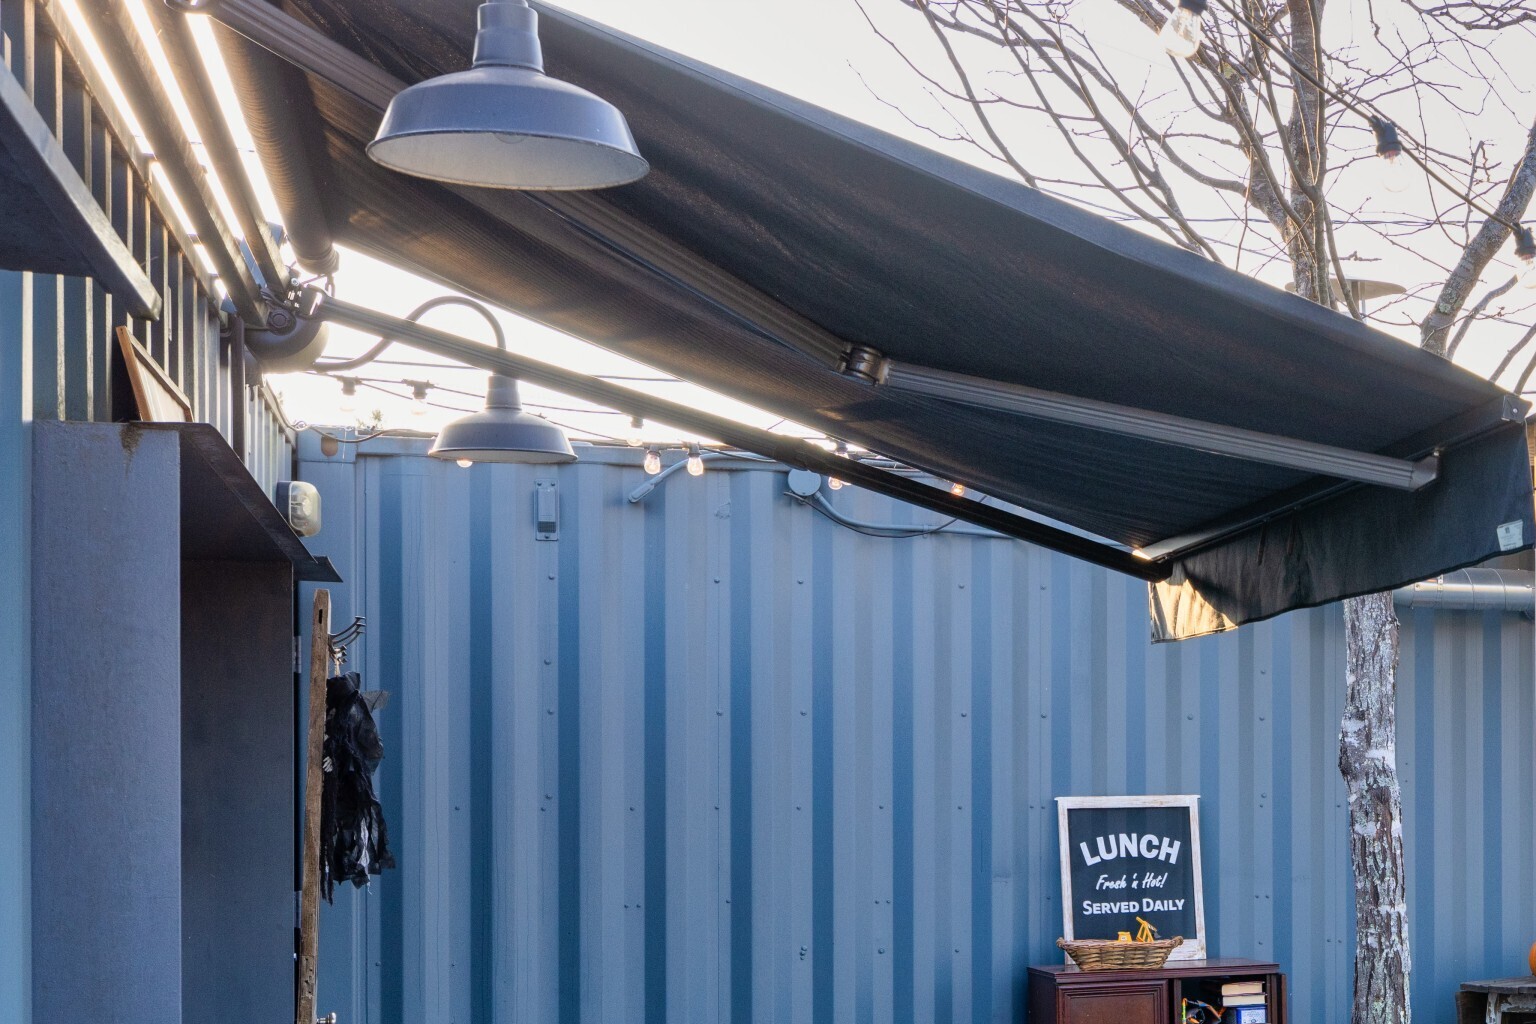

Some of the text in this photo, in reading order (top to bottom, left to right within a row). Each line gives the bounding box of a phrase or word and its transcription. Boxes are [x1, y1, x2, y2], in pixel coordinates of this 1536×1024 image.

[1079, 833, 1181, 866] LUNCH
[1095, 874, 1127, 890] Fresh
[1142, 872, 1168, 888] Hot!
[1082, 898, 1184, 915] SERVED DAILY
